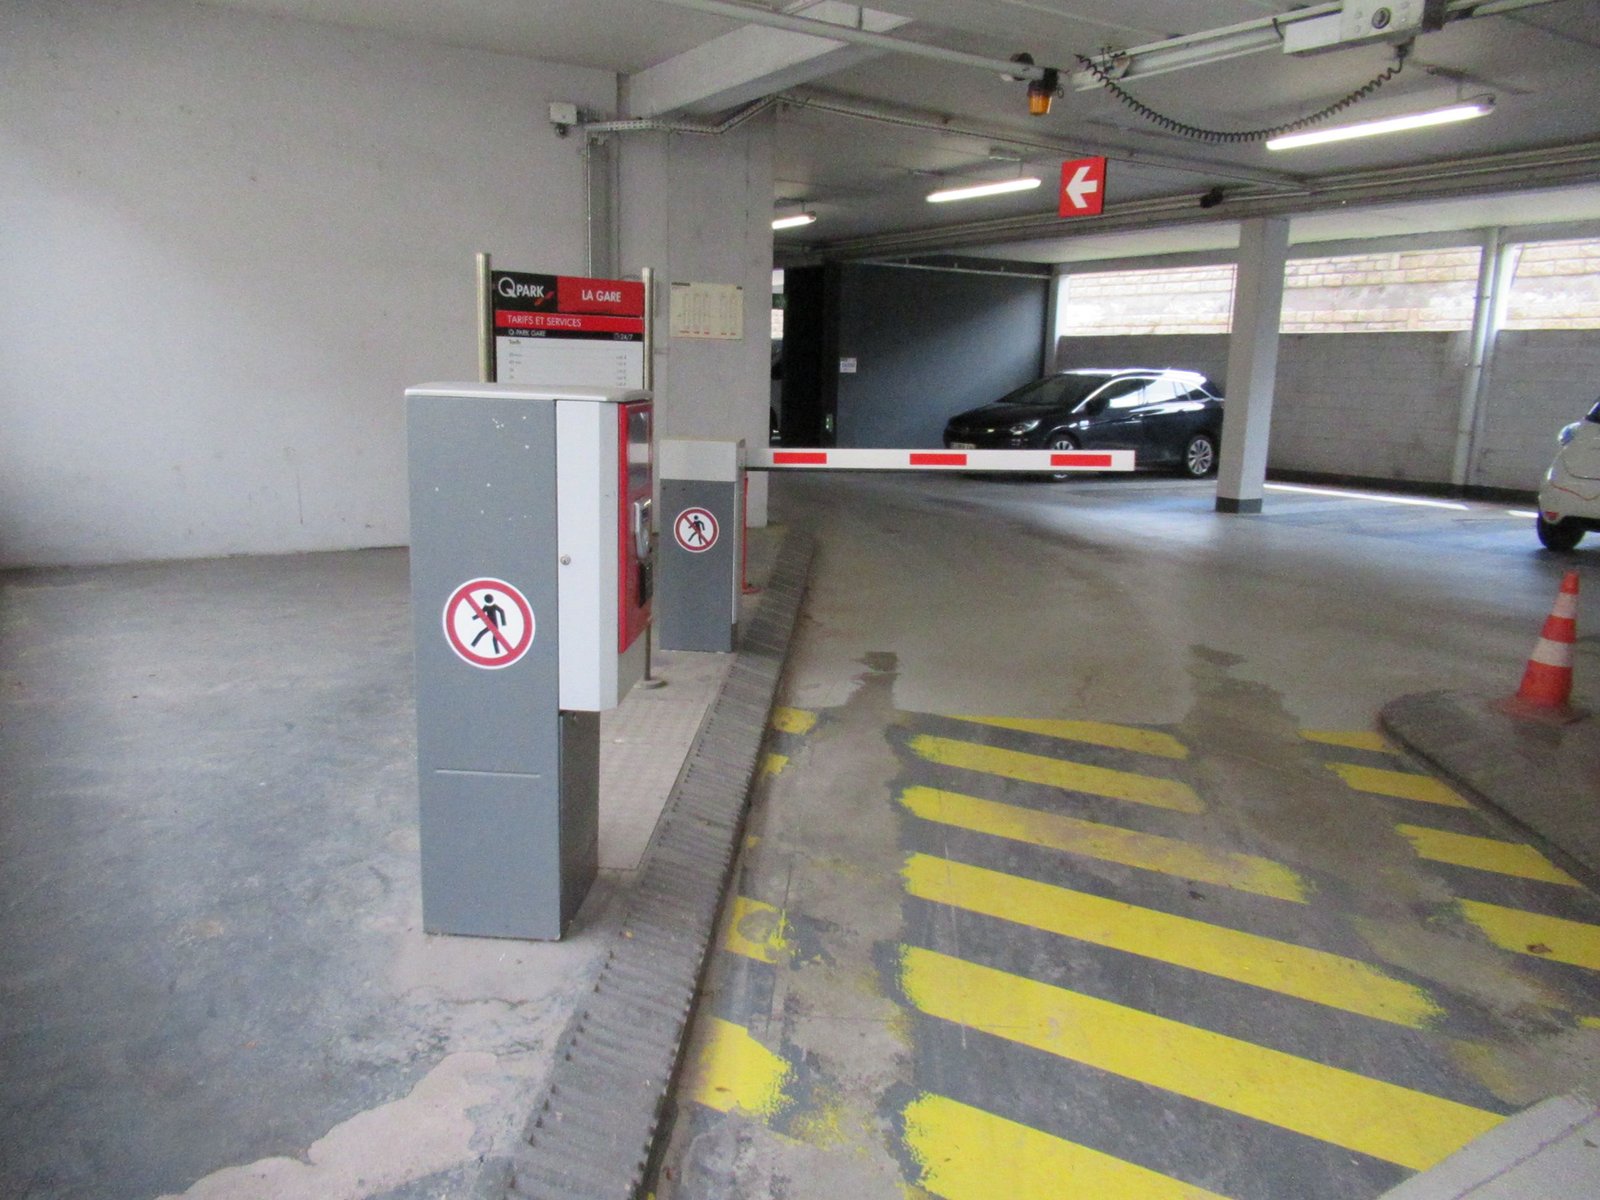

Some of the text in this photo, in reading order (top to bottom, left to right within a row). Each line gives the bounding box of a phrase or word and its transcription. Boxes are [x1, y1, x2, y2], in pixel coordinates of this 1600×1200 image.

[582, 289, 621, 303] LA GARE
[507, 315, 581, 328] TARIFS ET SERVICES
